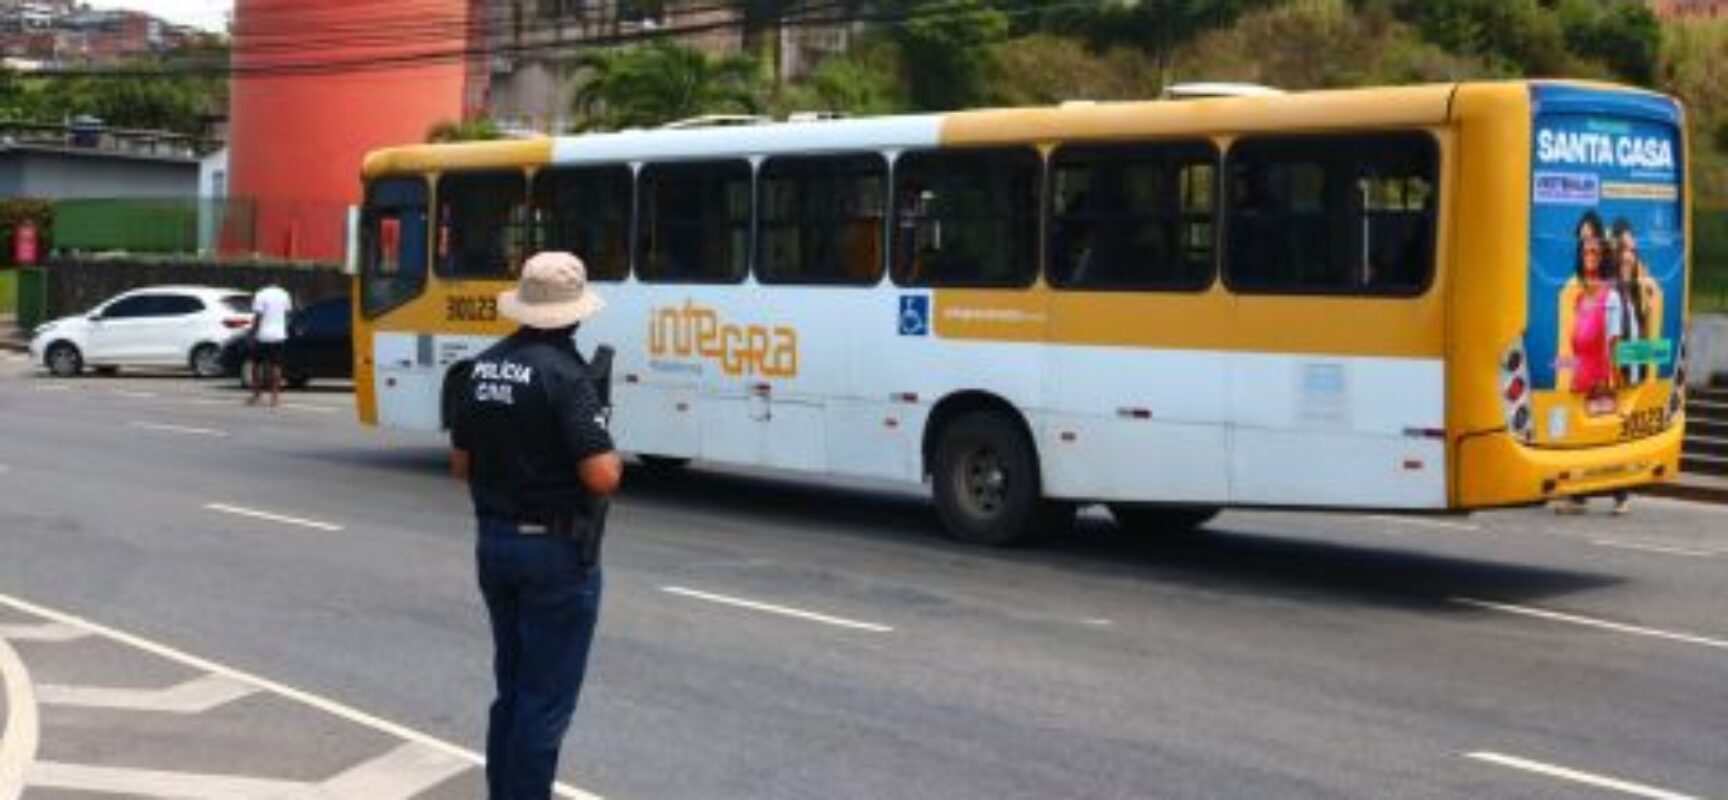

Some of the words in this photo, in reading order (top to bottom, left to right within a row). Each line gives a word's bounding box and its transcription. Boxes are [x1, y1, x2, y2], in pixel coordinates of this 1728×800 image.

[1538, 129, 1613, 165] SANTA
[1616, 136, 1672, 167] CASA
[471, 360, 533, 385] POLÍCIA
[476, 382, 514, 404] CIVIL
